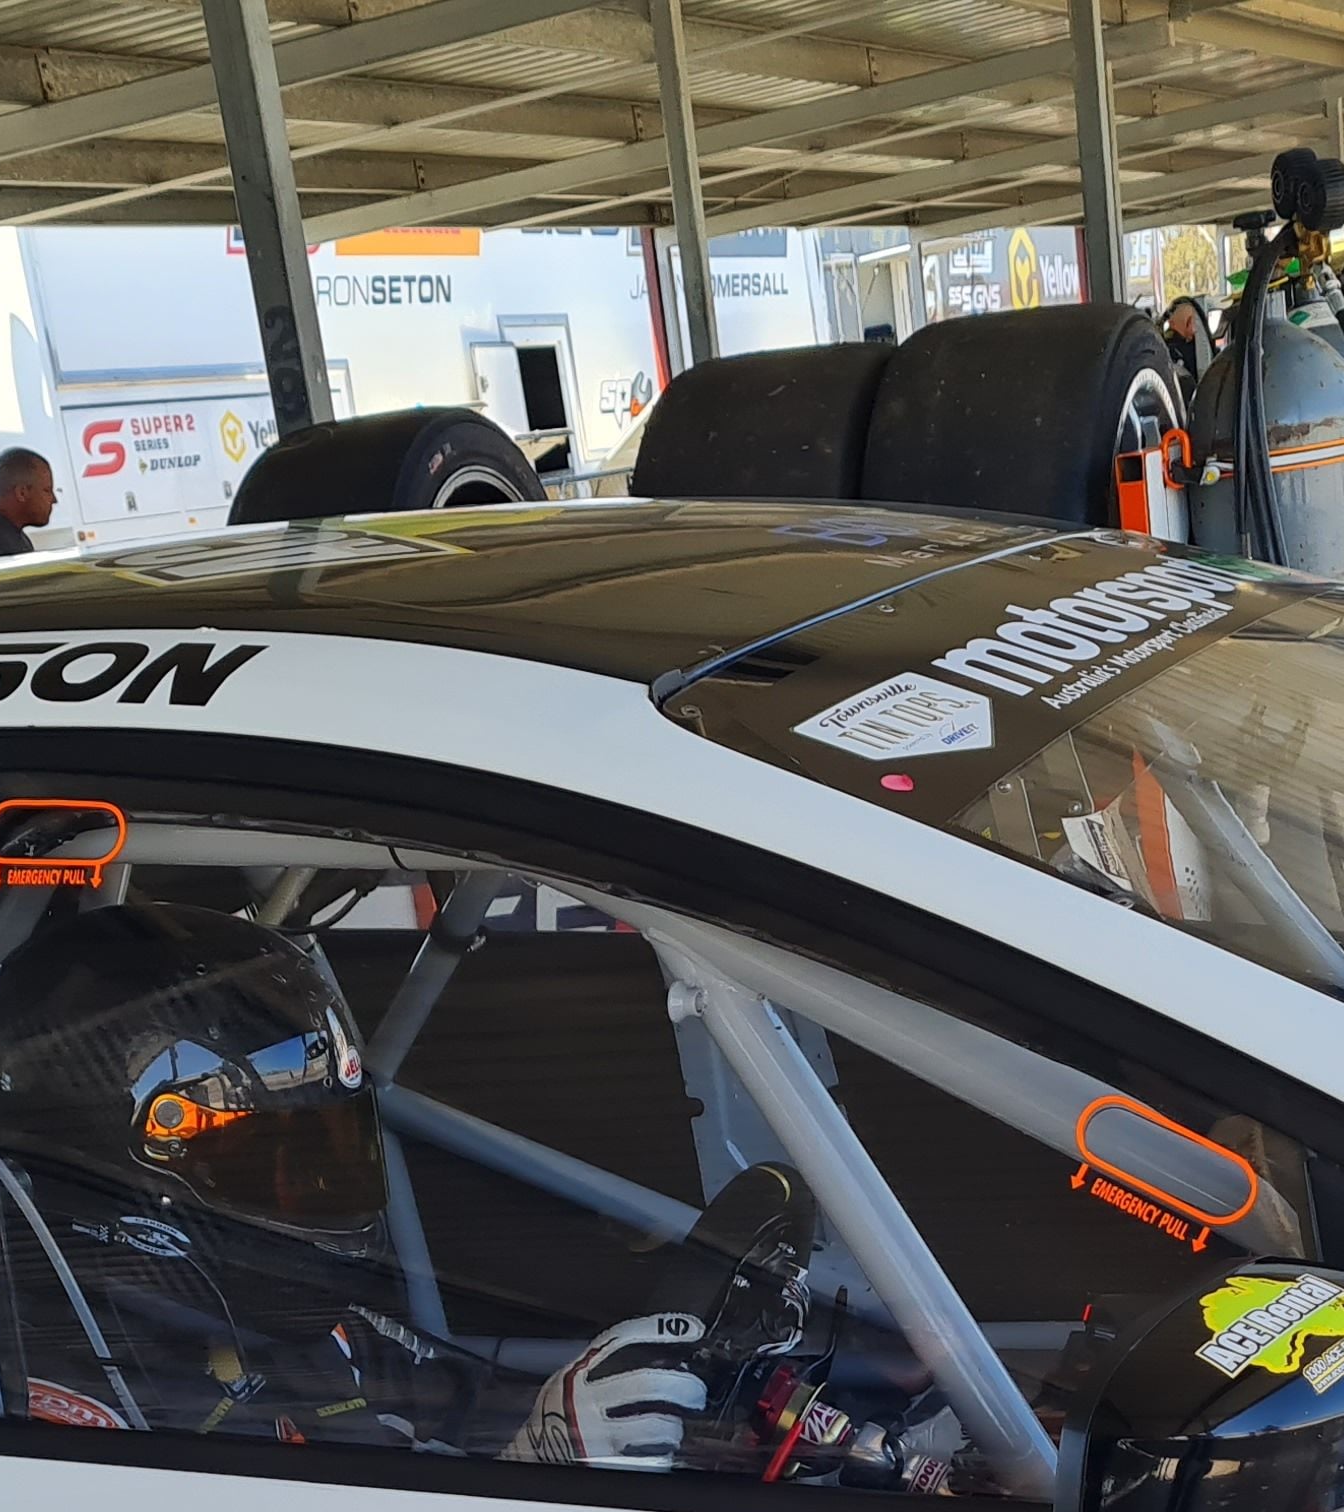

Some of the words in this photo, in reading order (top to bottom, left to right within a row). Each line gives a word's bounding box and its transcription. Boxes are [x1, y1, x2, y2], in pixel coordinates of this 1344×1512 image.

[130, 415, 182, 436] SUPER
[186, 414, 196, 431] 2
[248, 419, 278, 449] Yell
[134, 438, 169, 452] SERIES
[149, 457, 201, 472] DUNLOP
[1040, 664, 1122, 710] Australia's
[1107, 629, 1184, 669] Motorsport
[819, 683, 916, 729] Townsville
[838, 719, 914, 751] TIN
[879, 691, 965, 728] TOPS
[7, 869, 61, 886] EMERGENCY
[63, 868, 86, 885] PULL
[1090, 1178, 1163, 1226] EMERGENCY
[1154, 1210, 1191, 1241] PULL
[1306, 1359, 1329, 1380] 1300
